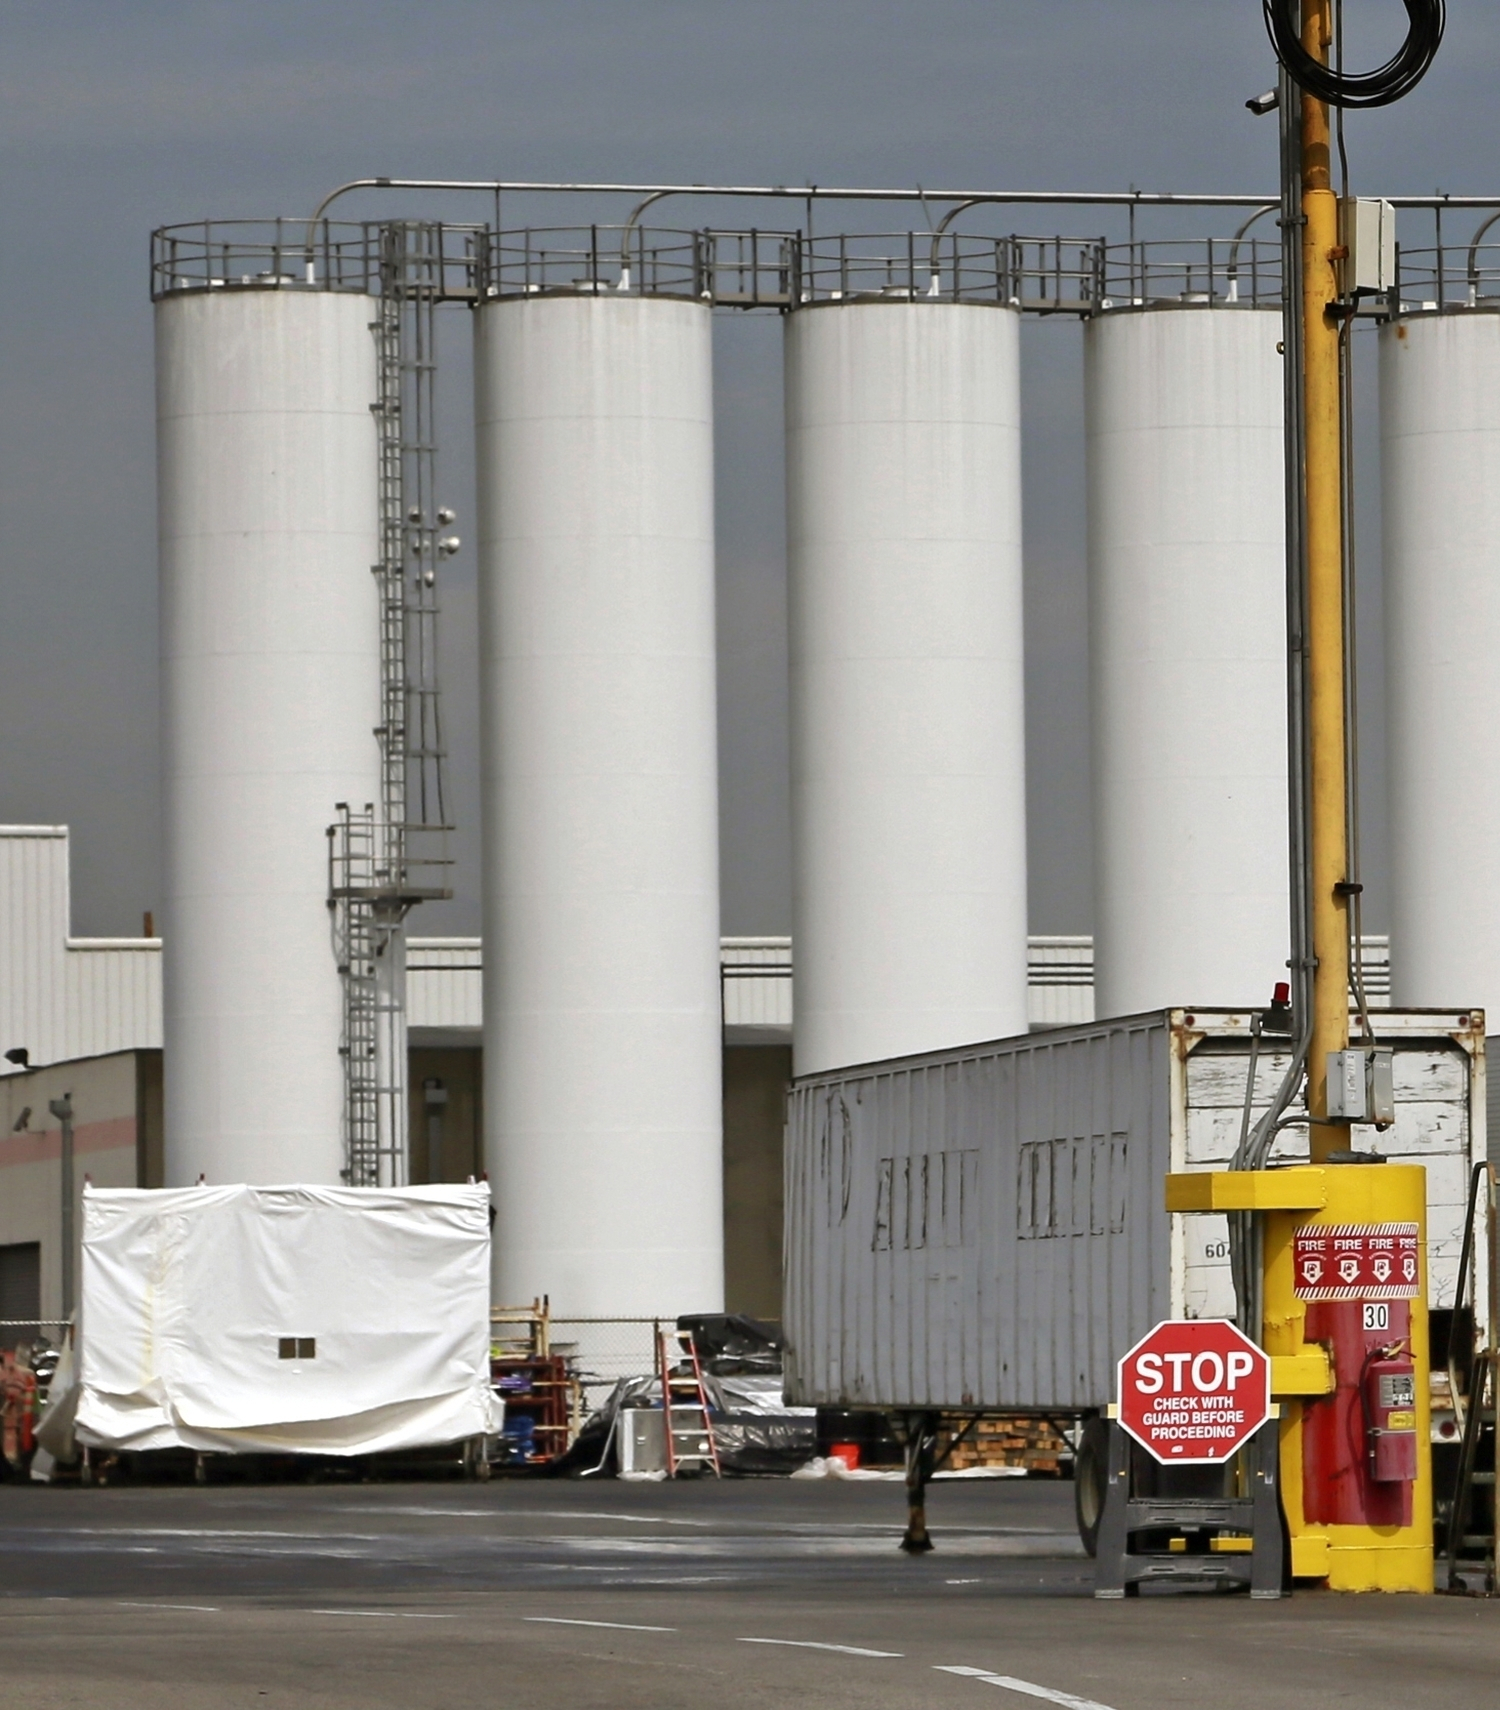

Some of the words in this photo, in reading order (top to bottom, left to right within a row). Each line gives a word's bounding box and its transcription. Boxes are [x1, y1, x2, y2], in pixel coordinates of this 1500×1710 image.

[1205, 1243, 1231, 1258] 60
[1298, 1240, 1326, 1251] FIRE
[1334, 1239, 1363, 1250] FIRE
[1368, 1238, 1394, 1249] FIRE
[1365, 1305, 1387, 1328] 30
[1135, 1351, 1254, 1395] STOP
[1153, 1396, 1198, 1411] CHECK
[1201, 1395, 1234, 1409] WITH
[1142, 1412, 1188, 1426] GUARD
[1192, 1410, 1244, 1424] BEFORE
[1151, 1424, 1236, 1440] PROCEEDING
